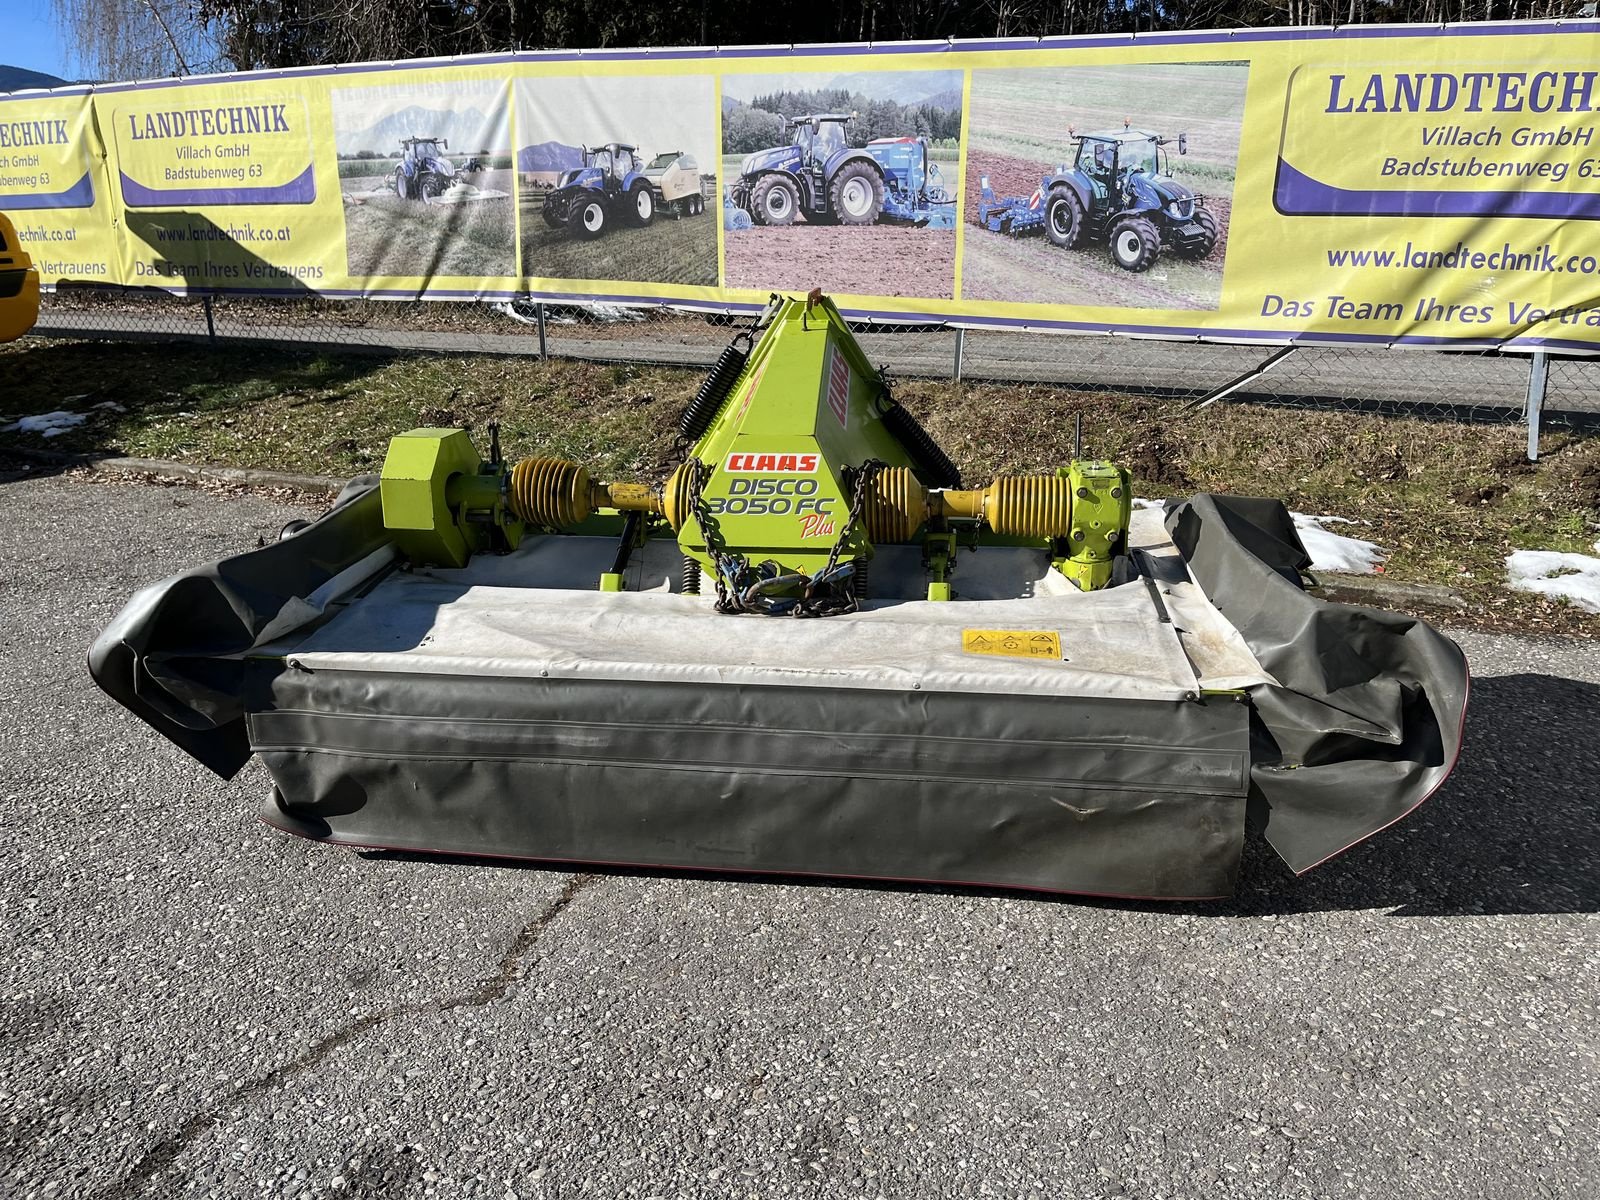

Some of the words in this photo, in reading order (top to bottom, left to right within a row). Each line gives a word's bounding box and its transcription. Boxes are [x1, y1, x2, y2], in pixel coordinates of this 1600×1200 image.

[1325, 71, 1600, 113] LANDTECH
[129, 105, 289, 140] LANDTECHNIK
[1422, 126, 1502, 147] Villach
[1511, 126, 1594, 147] GmbH
[12, 154, 39, 168] GmbH
[176, 146, 211, 160] Villach
[215, 144, 250, 158] GmbH
[40, 172, 50, 185] 63
[165, 165, 245, 181] Badstubenweg
[249, 164, 263, 178] 63
[1380, 157, 1569, 182] Badstubenweg
[16, 225, 77, 241] echnik.co.at
[157, 223, 291, 243] www.landtechnik.co.at
[40, 260, 106, 275] Vertrauens
[136, 261, 161, 277] Das
[166, 260, 199, 278] Team
[204, 259, 239, 279] Ihres
[244, 261, 324, 280] Vertrauens
[1261, 295, 1314, 318] Das
[1326, 296, 1404, 321] Team
[1413, 298, 1493, 324] Ihres
[727, 455, 817, 471] CLAAS
[728, 478, 818, 496] DISCO
[708, 498, 793, 515] 3050
[795, 498, 836, 515] FC
[799, 513, 835, 538] Plus
